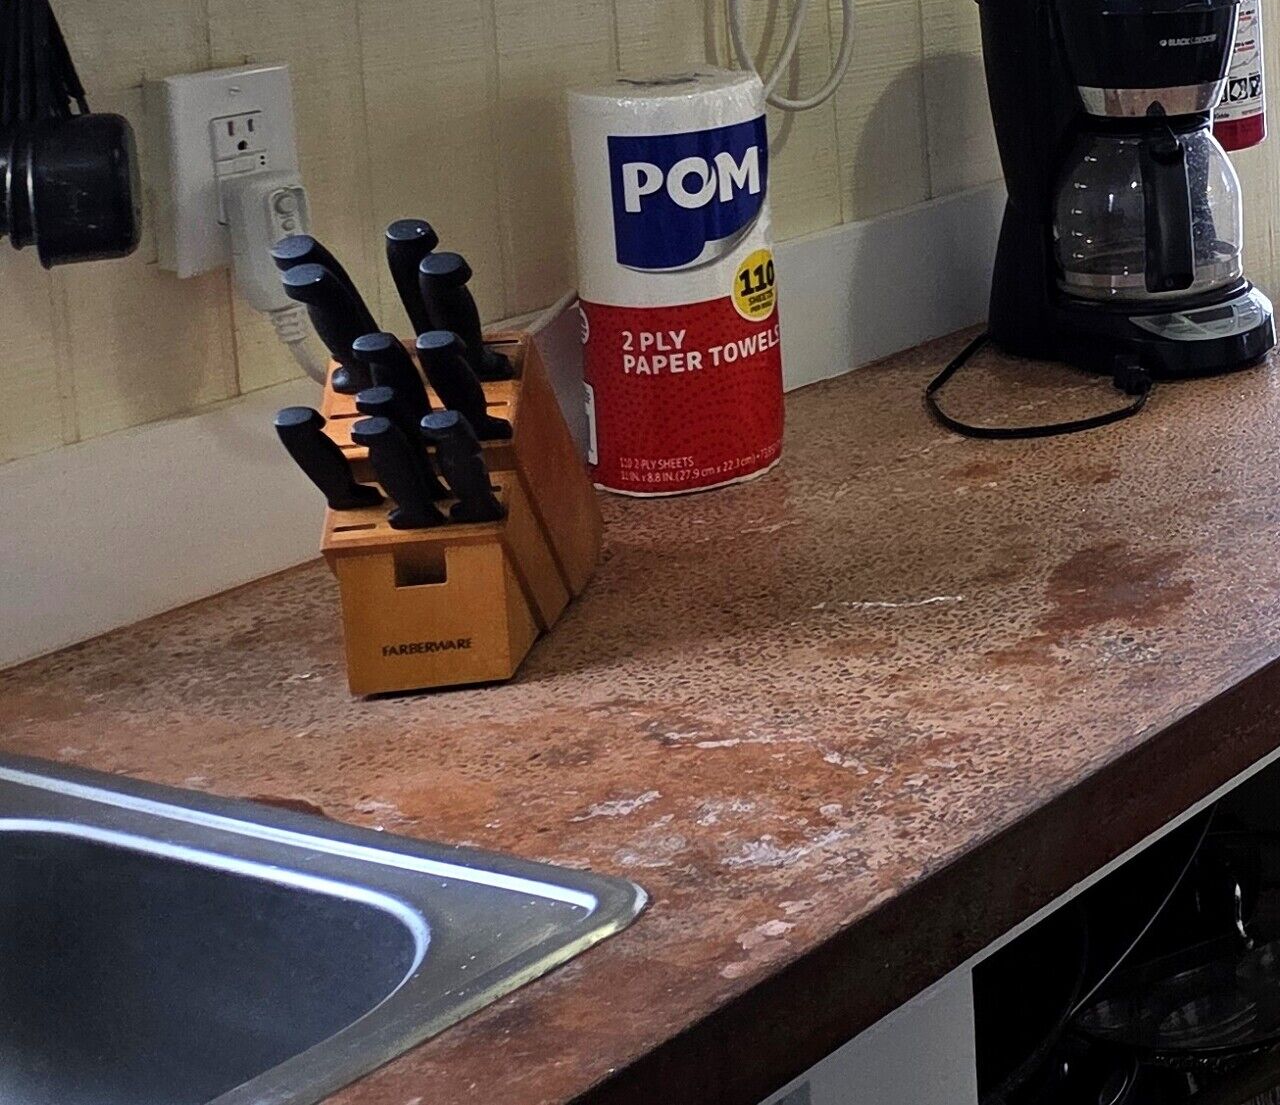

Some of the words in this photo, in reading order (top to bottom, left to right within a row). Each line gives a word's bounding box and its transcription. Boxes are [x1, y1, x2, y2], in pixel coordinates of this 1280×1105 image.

[622, 145, 761, 213] POM
[739, 259, 775, 297] 110
[621, 330, 634, 351] 2
[639, 329, 687, 352] PLY
[623, 351, 704, 375] PAPER
[657, 455, 695, 470] SHEETS
[382, 638, 472, 656] FARBERWARE
